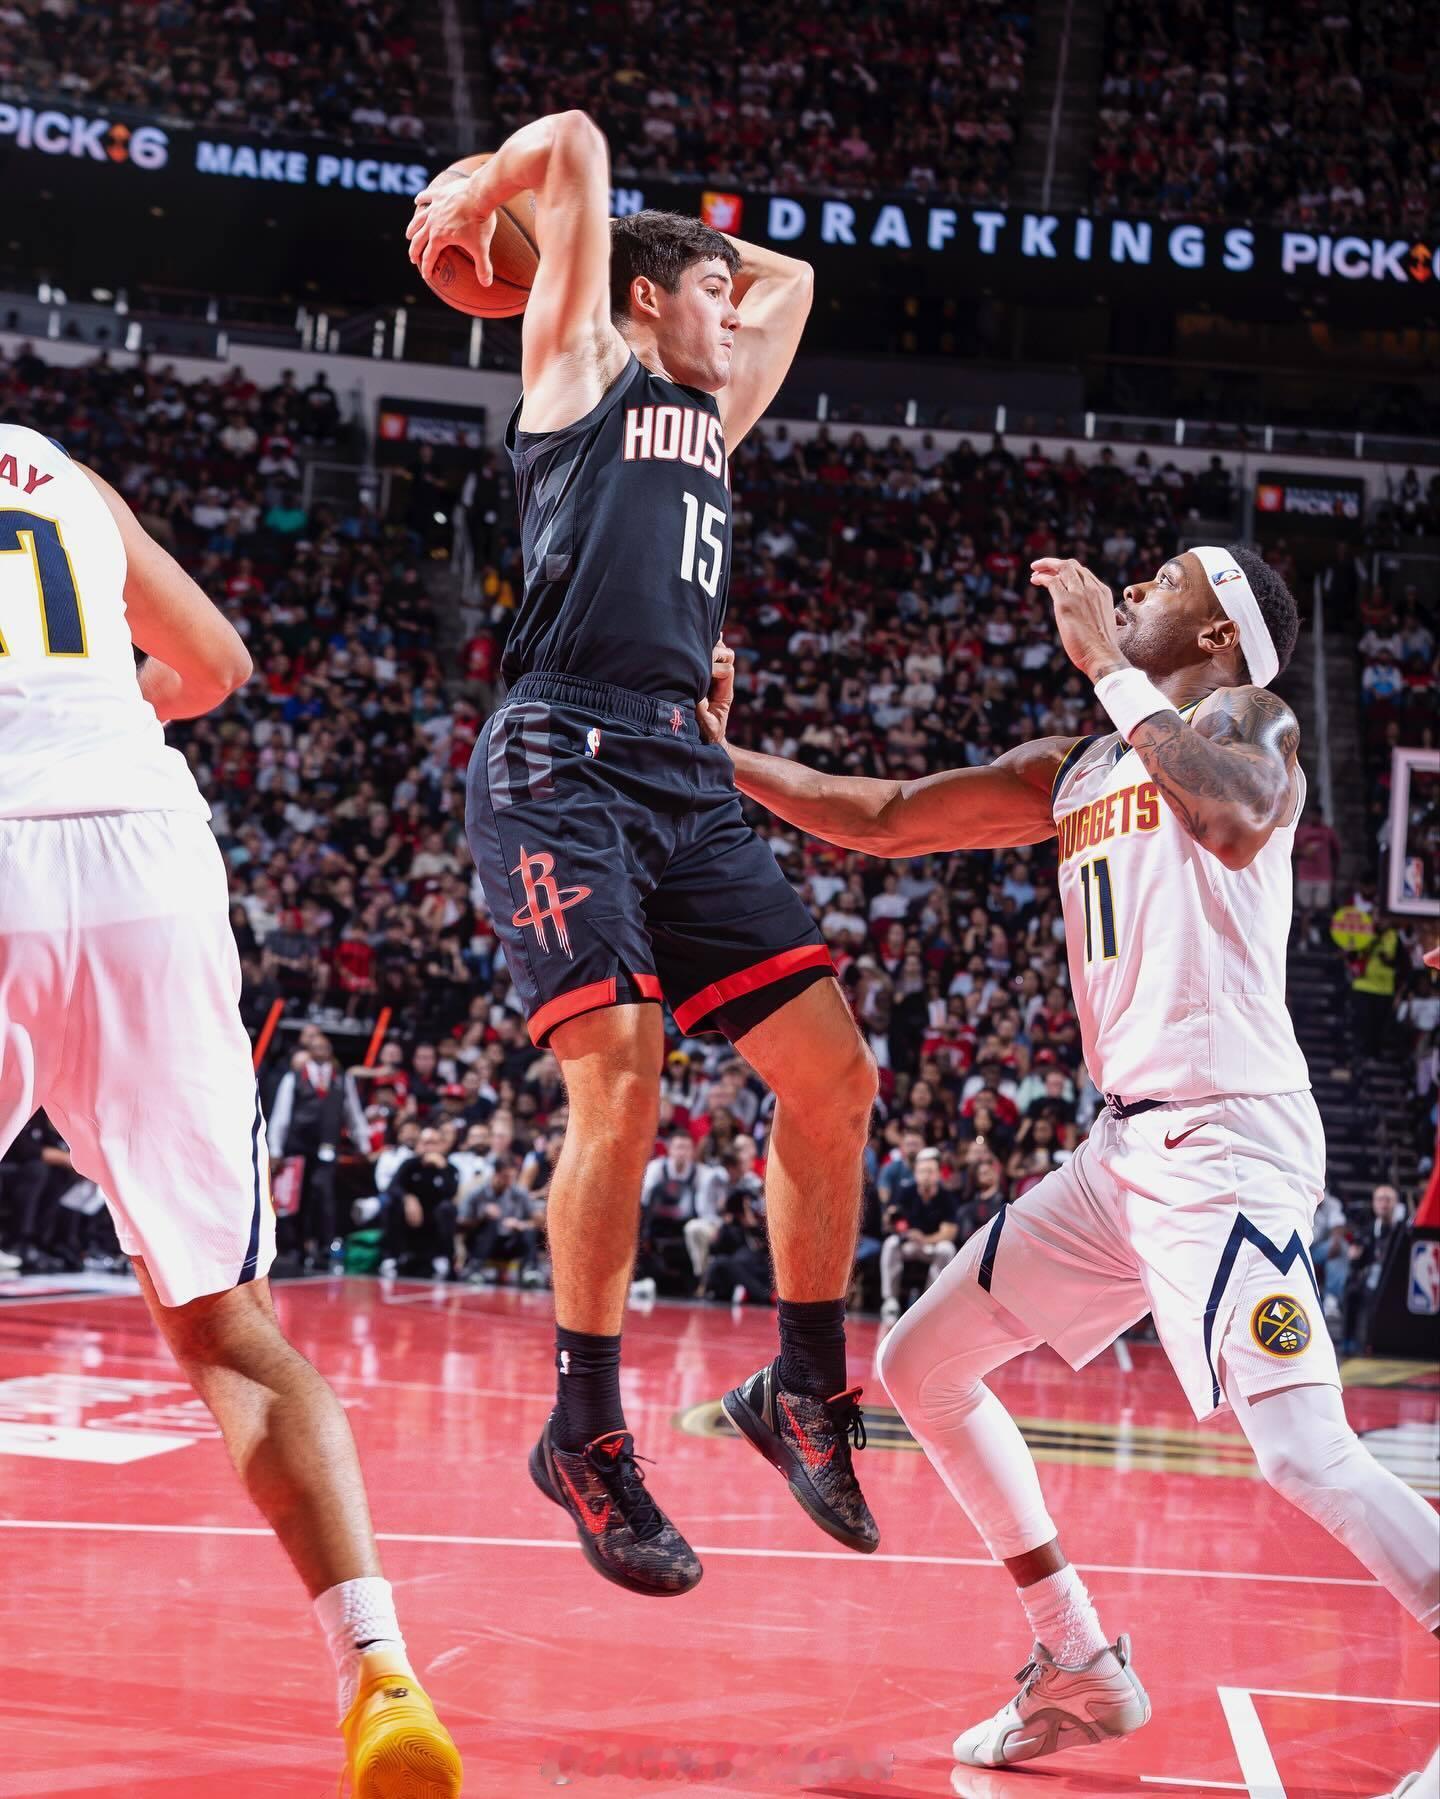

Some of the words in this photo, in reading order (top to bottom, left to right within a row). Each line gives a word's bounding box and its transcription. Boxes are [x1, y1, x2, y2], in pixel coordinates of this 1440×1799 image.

[196, 141, 308, 184] MAKE
[316, 154, 429, 196] PICKS
[767, 197, 1256, 272] DRAFTKINGS
[1281, 232, 1440, 282] PICK
[623, 404, 730, 494] HOUS
[681, 491, 727, 599] 15
[1057, 781, 1162, 866] NUGGETS
[1080, 856, 1119, 963] 11
